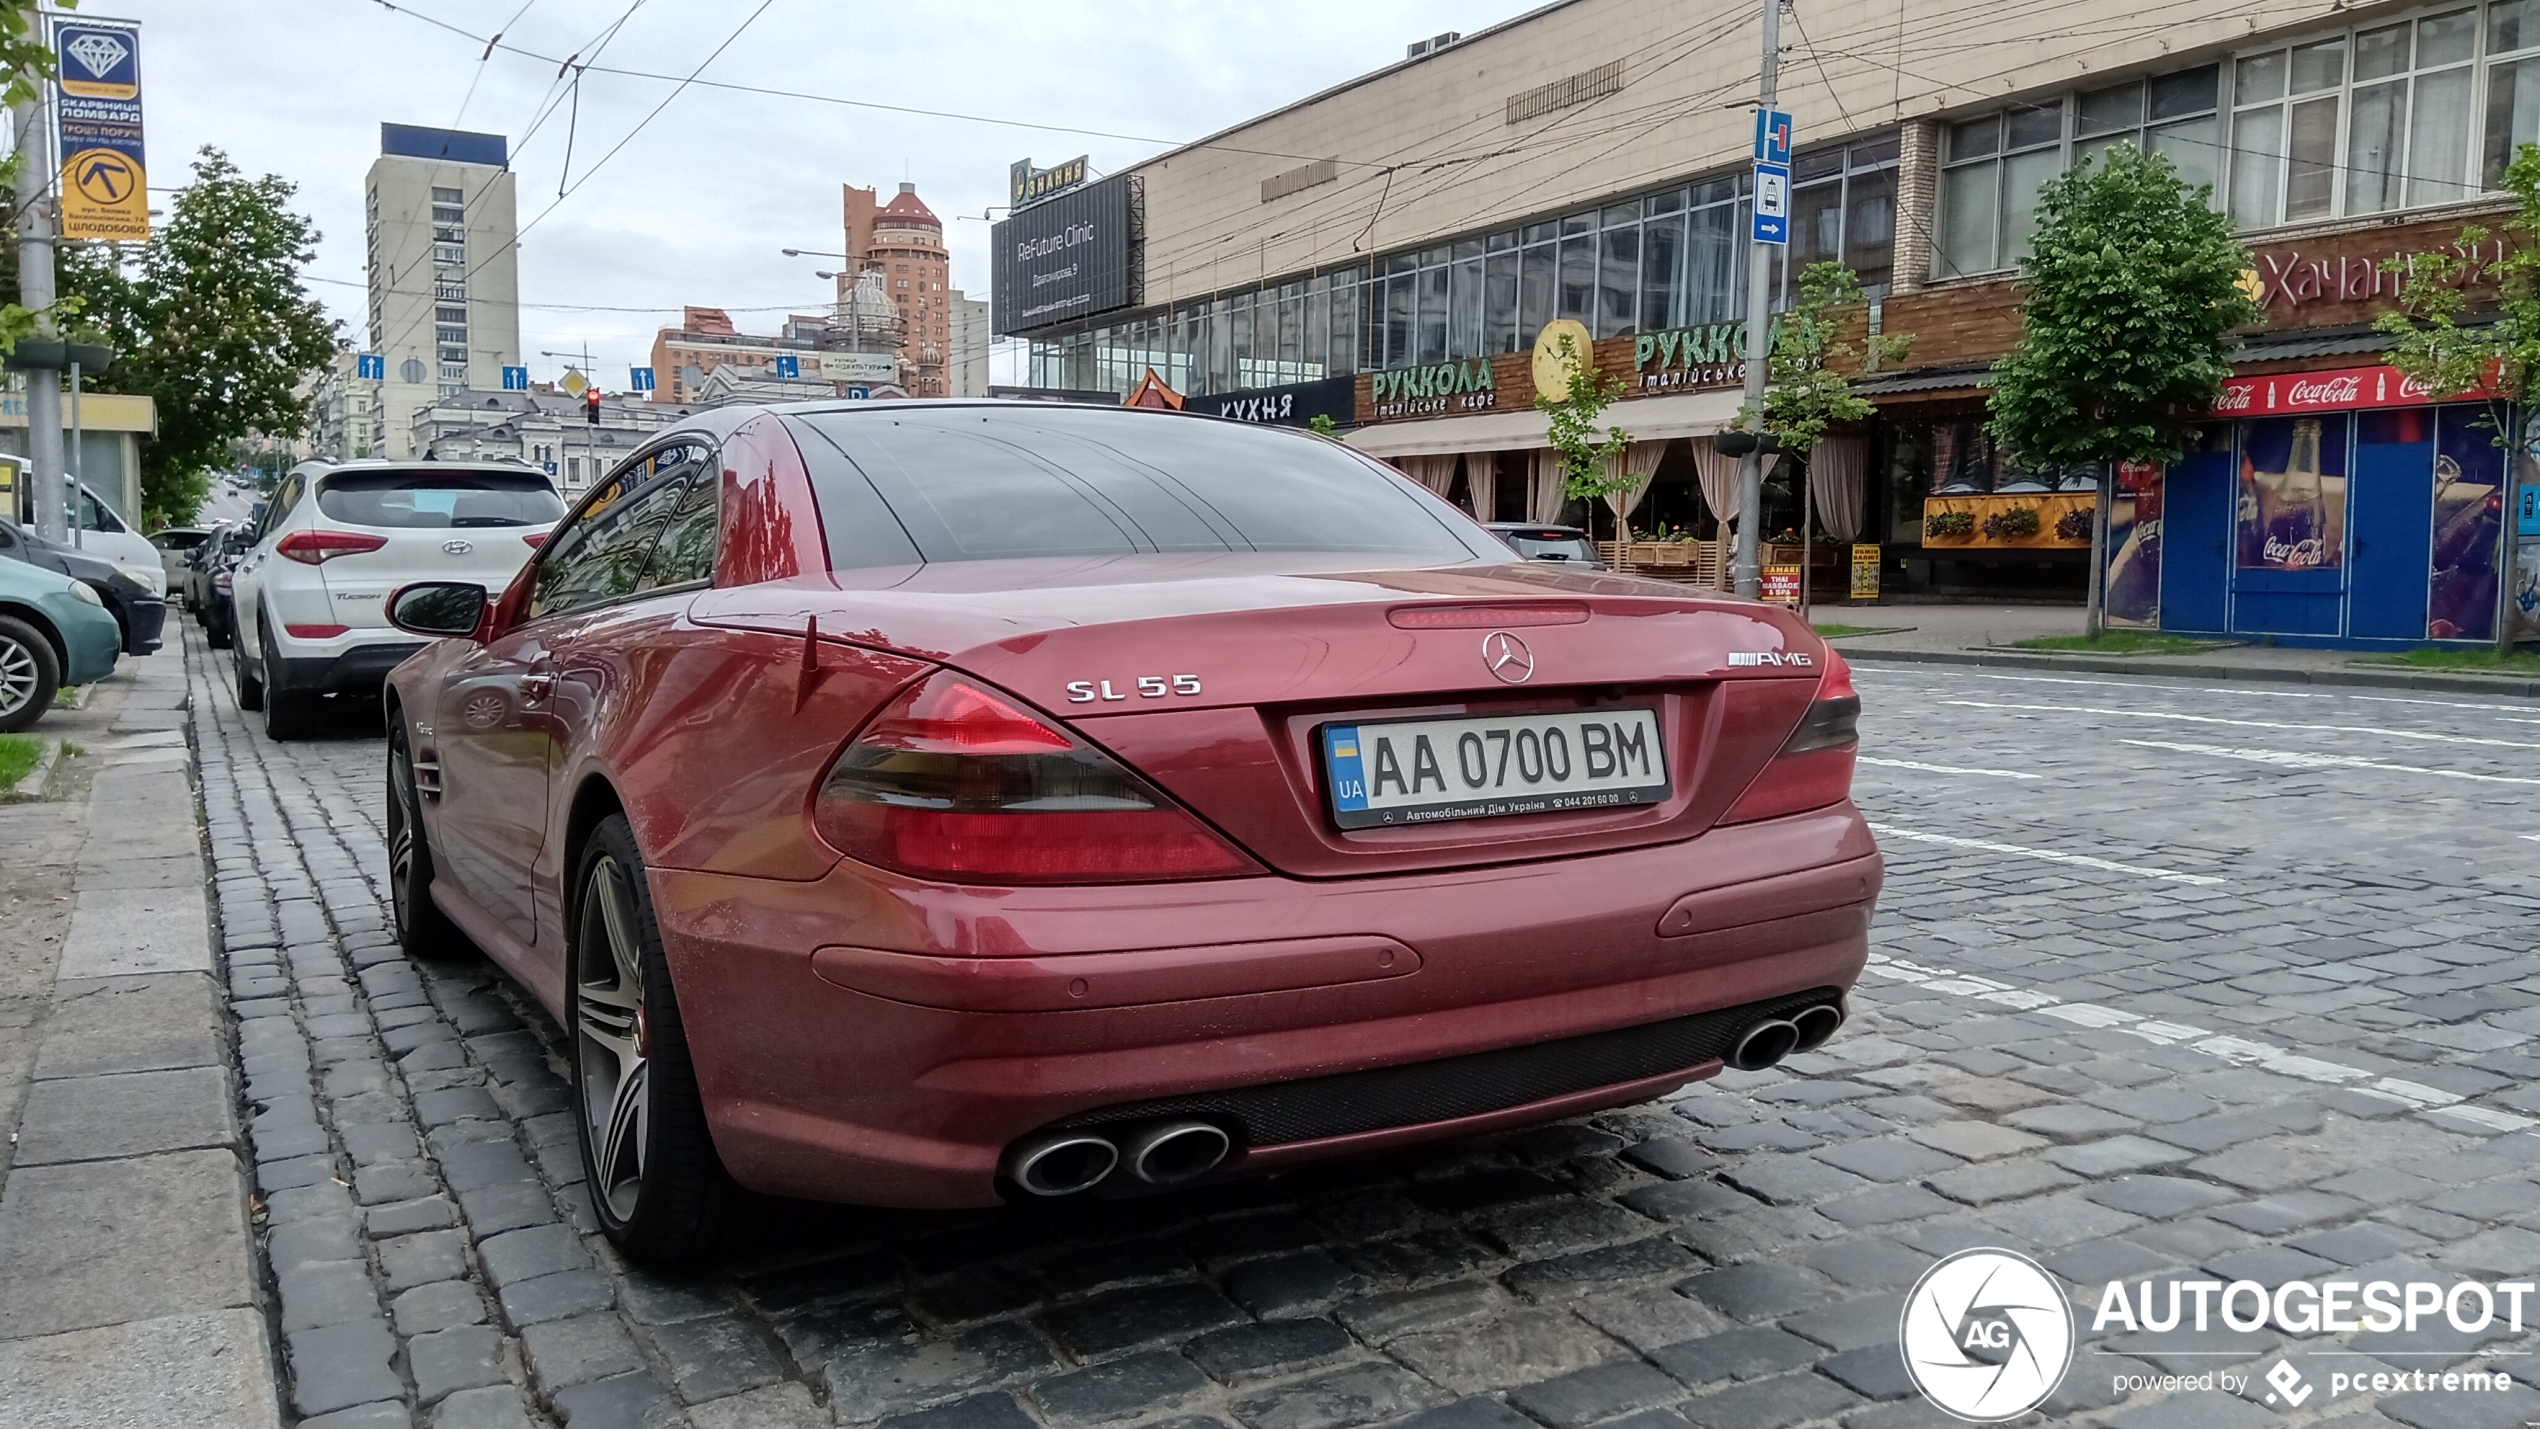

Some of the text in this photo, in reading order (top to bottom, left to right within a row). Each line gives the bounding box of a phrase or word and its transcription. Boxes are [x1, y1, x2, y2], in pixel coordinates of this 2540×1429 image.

[61, 98, 140, 112] СКАРБНИЦЯ
[61, 107, 141, 123] ЛОМБАРД
[1028, 161, 1082, 196] ЗНАННЯ
[68, 222, 146, 235] ЦІЛОДОБОВО
[1018, 220, 1094, 262] ReFuture Clinic
[1372, 359, 1496, 403] РУККОЛА
[1638, 364, 1746, 388] італійське
[1374, 391, 1494, 417] італійське кафе
[2288, 376, 2363, 406] Coca-Cola
[2263, 535, 2323, 566] Coca-Cola
[335, 592, 382, 600] TUCSON
[1757, 652, 1813, 667] AMG
[1066, 674, 1202, 704] SL 55
[1339, 722, 1651, 799] UA AA 0700 BM
[1406, 805, 1486, 821] Автомобільний
[1488, 803, 1506, 816] Дім
[1564, 797, 1581, 807] 044
[1582, 795, 1596, 806] 201
[1597, 794, 1608, 805] 60
[1608, 793, 1619, 804] 00
